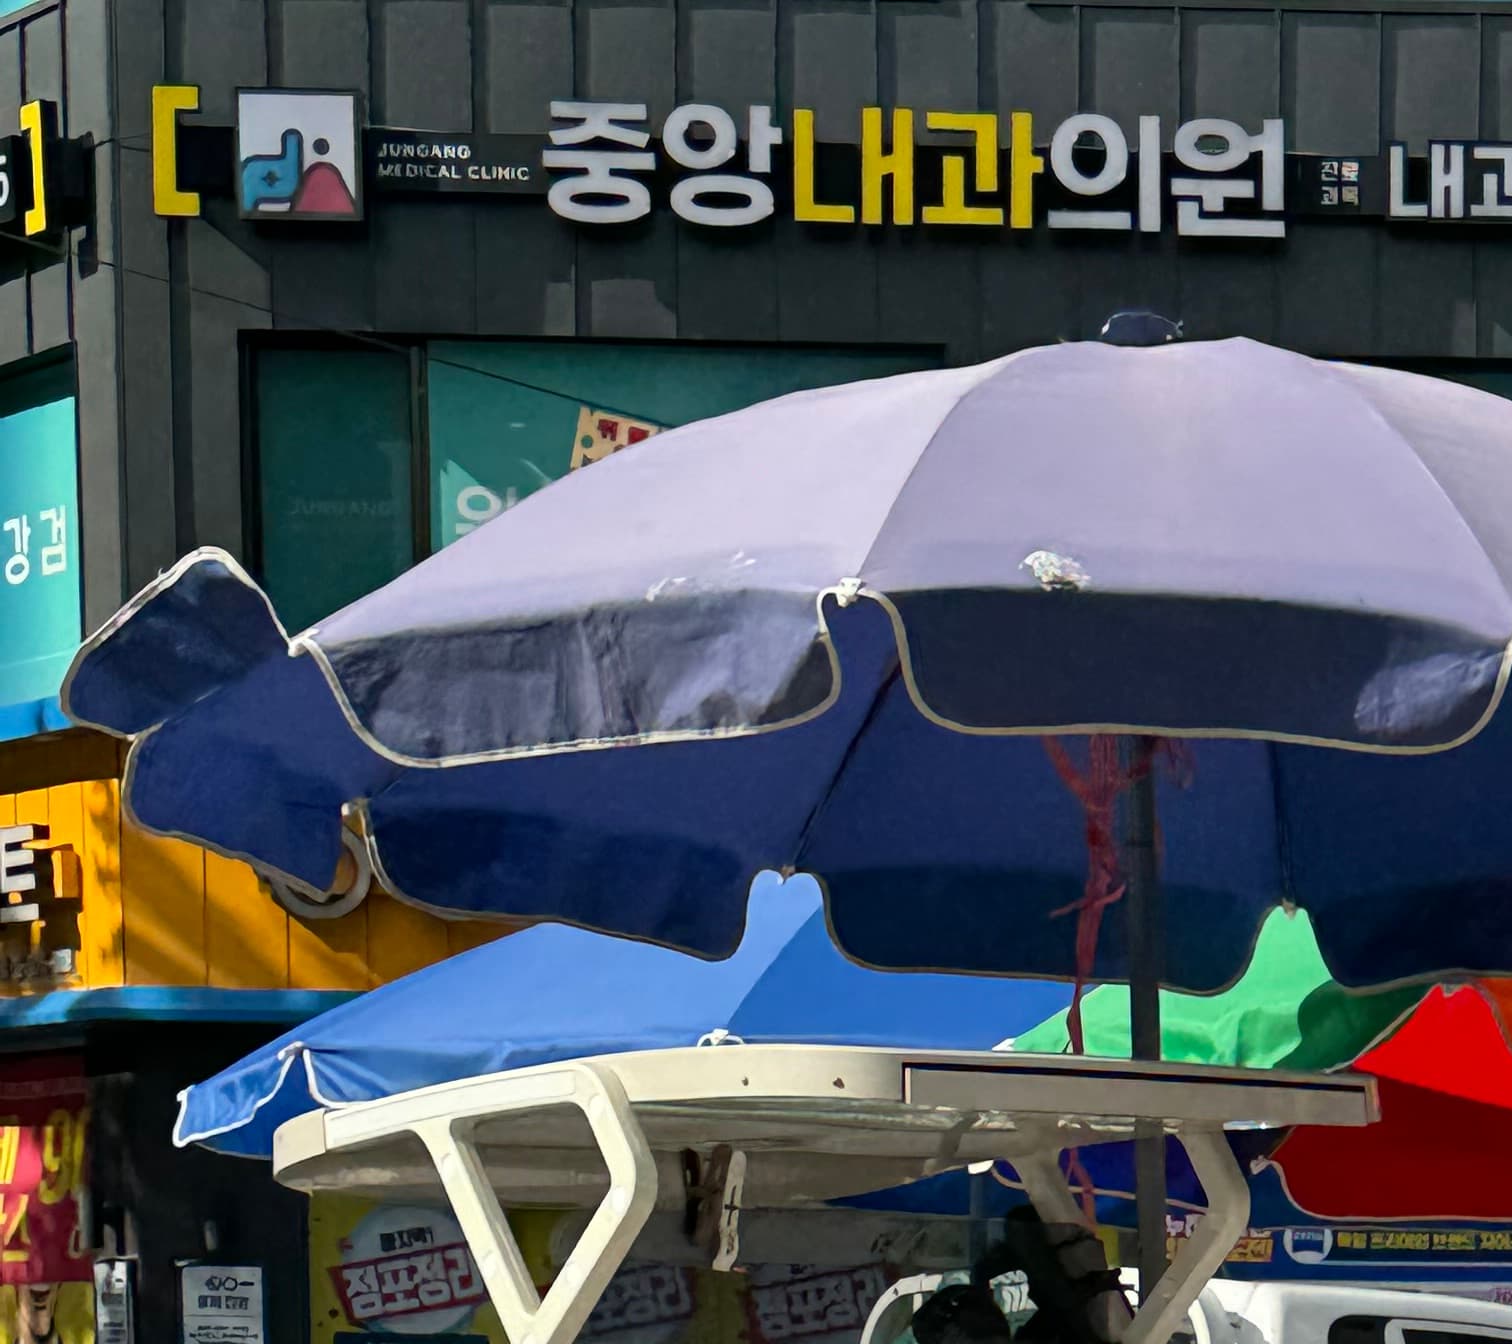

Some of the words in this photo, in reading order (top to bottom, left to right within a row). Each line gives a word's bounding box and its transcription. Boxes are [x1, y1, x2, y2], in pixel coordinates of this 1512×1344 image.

[378, 143, 471, 159] JUNGANG
[378, 163, 462, 179] MEDICAL
[468, 165, 530, 181] CLINIC
[542, 101, 1286, 237] 중앙내과의원
